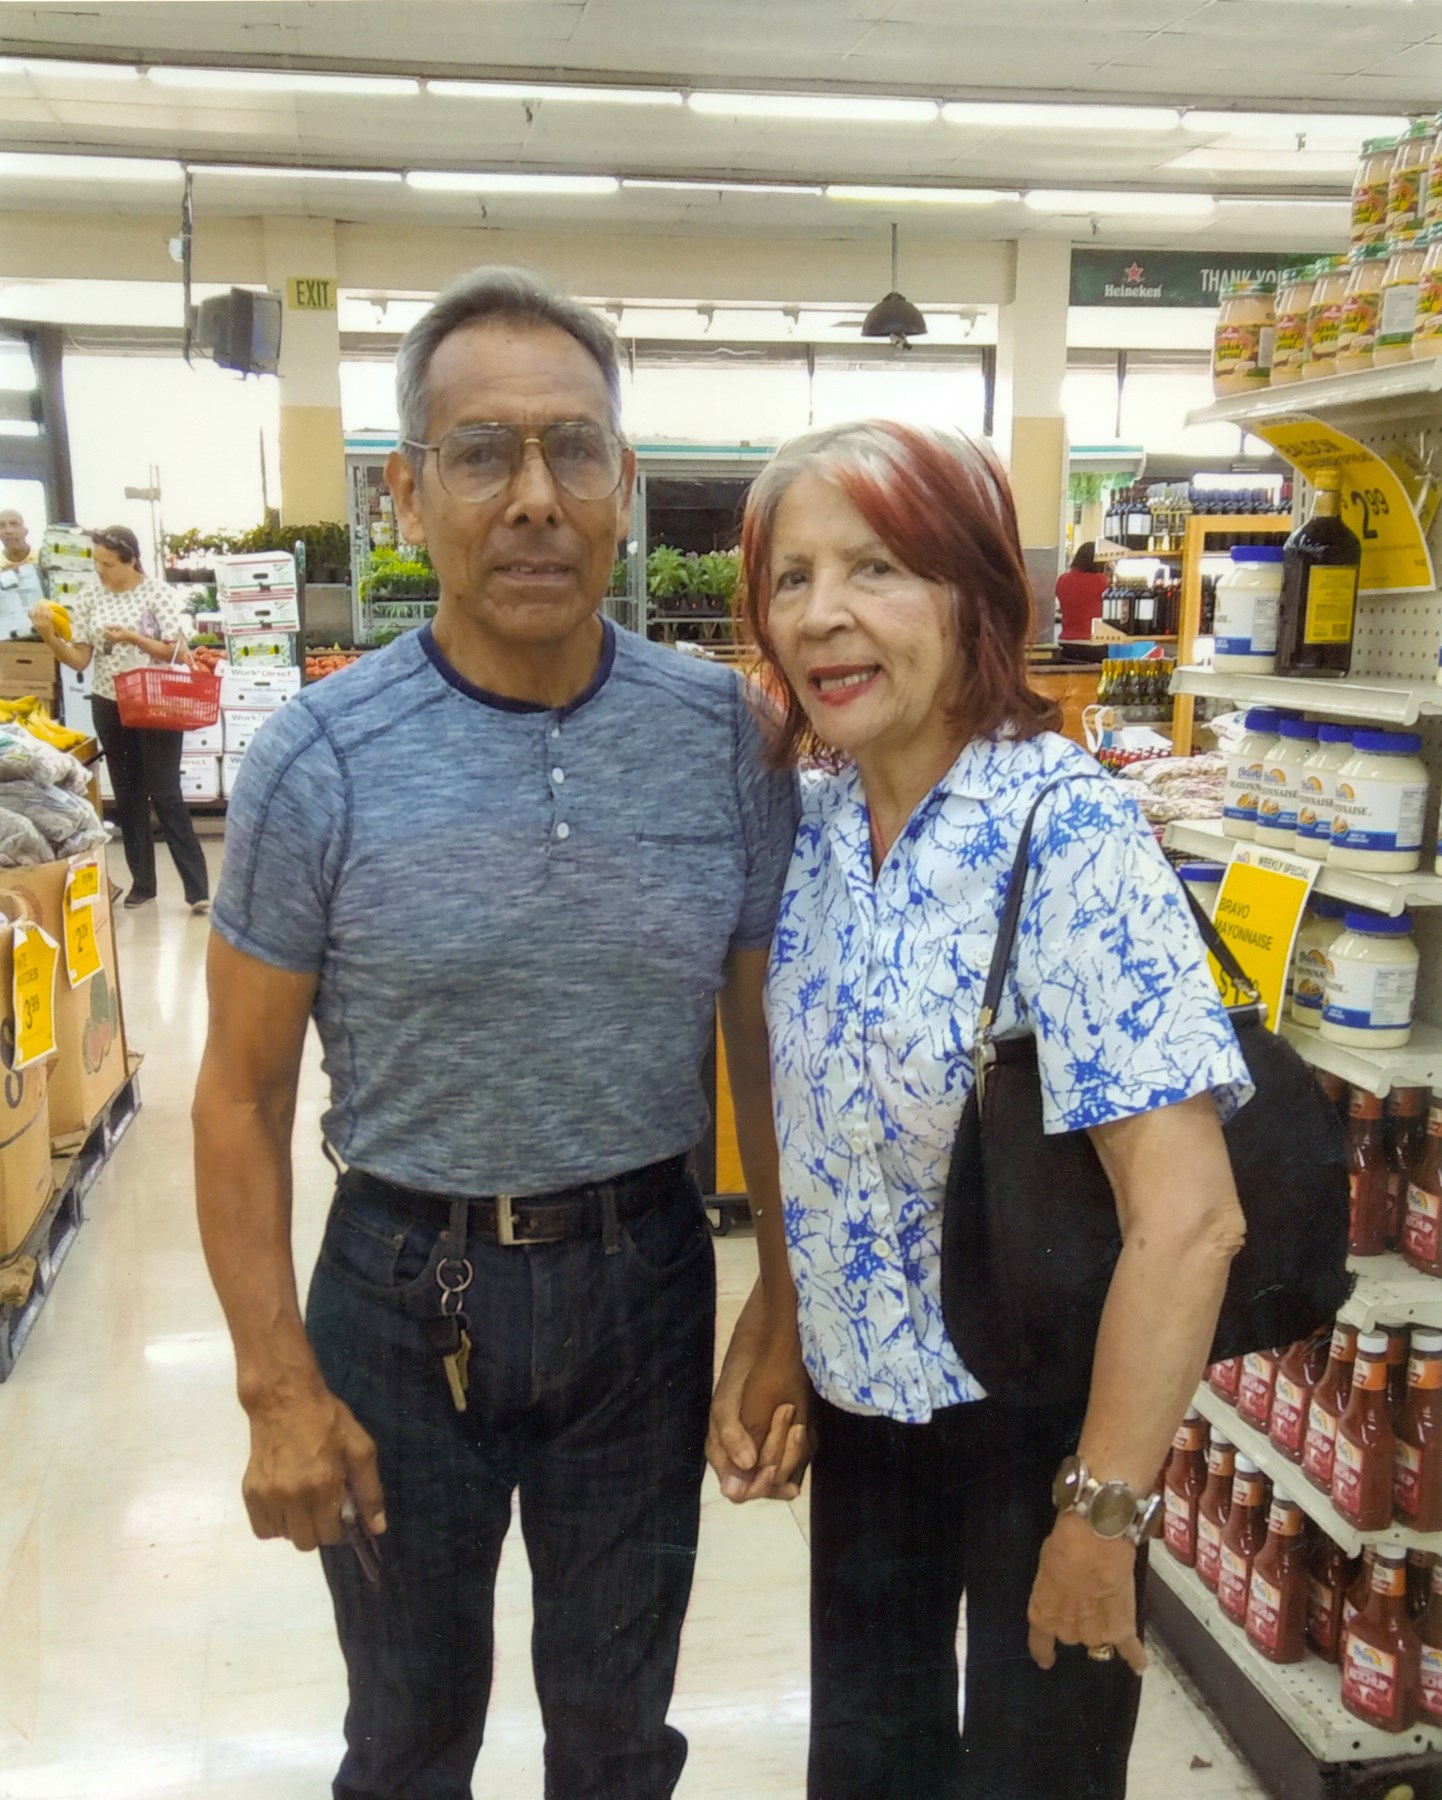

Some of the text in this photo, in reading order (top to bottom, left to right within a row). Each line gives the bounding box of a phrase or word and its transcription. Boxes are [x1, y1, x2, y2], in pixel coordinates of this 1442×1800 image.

[296, 280, 330, 307] EXIT
[1104, 284, 1162, 298] Heineken
[1258, 856, 1284, 871] WEEKLY
[1284, 863, 1310, 880] SPECIAL
[1219, 897, 1250, 920] BRAVO
[1215, 918, 1274, 951] MAYONNAISE
